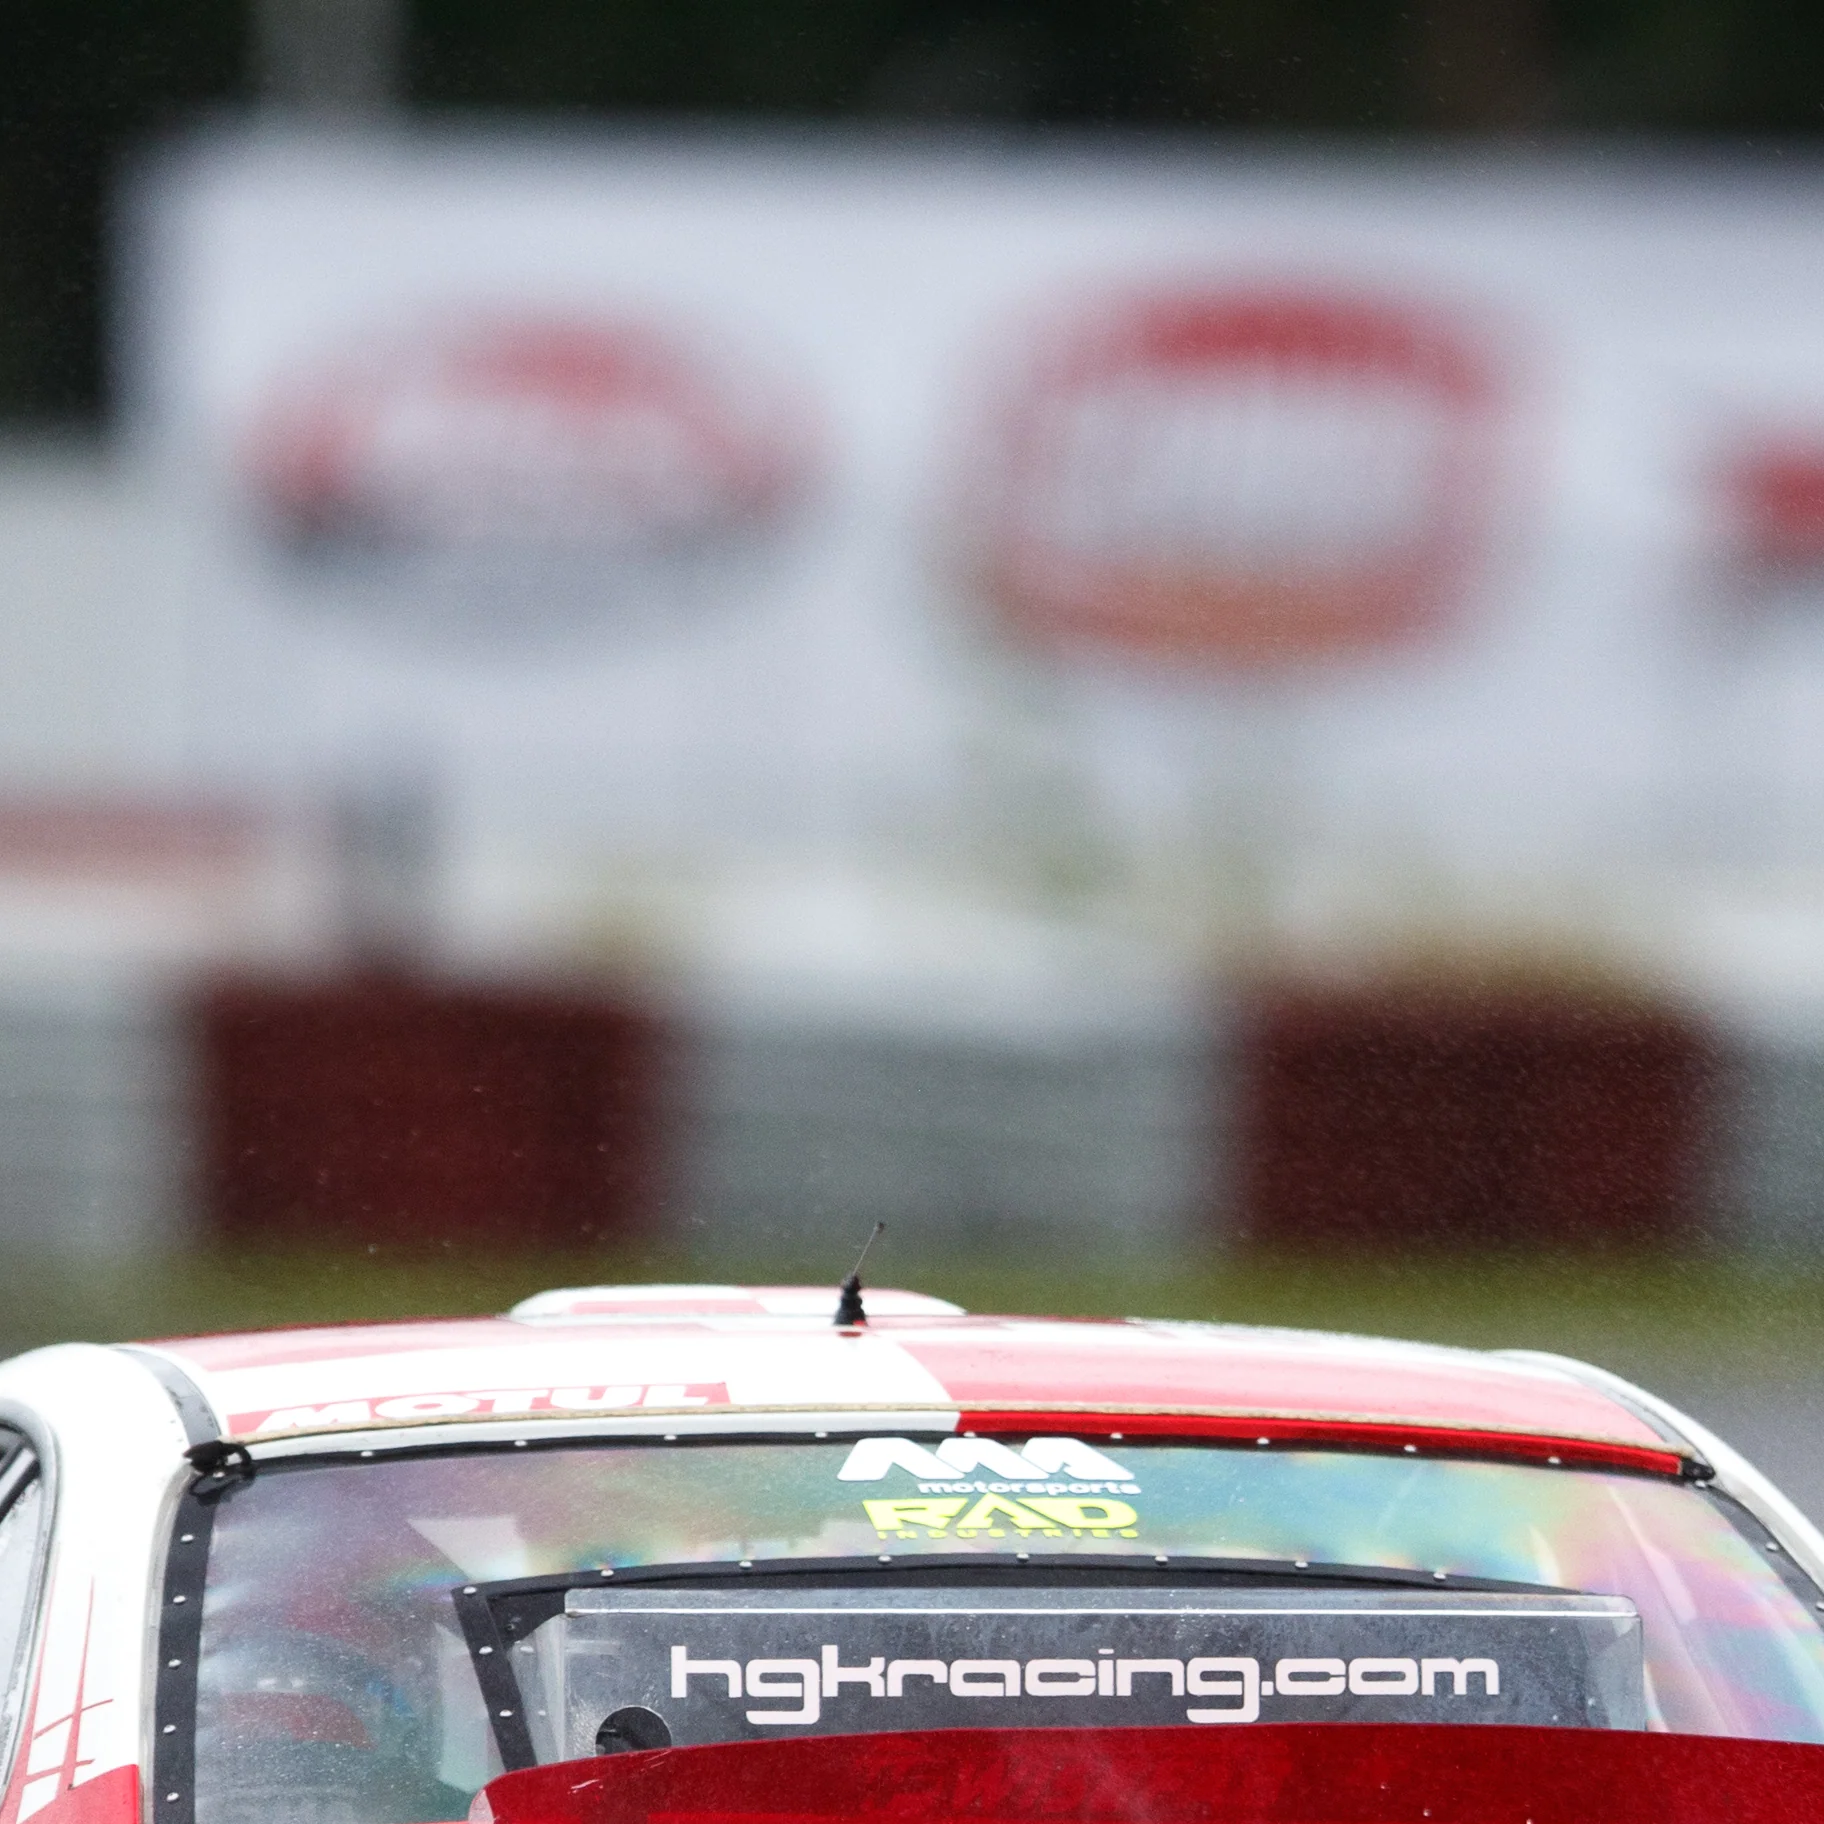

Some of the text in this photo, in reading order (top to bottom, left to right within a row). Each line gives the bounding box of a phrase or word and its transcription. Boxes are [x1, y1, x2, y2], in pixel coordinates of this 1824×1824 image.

[256, 1384, 712, 1433] MOTUL
[917, 1480, 1142, 1496] motorsports
[862, 1493, 1138, 1530] RAD
[670, 1644, 1500, 1725] hgkracing.com
